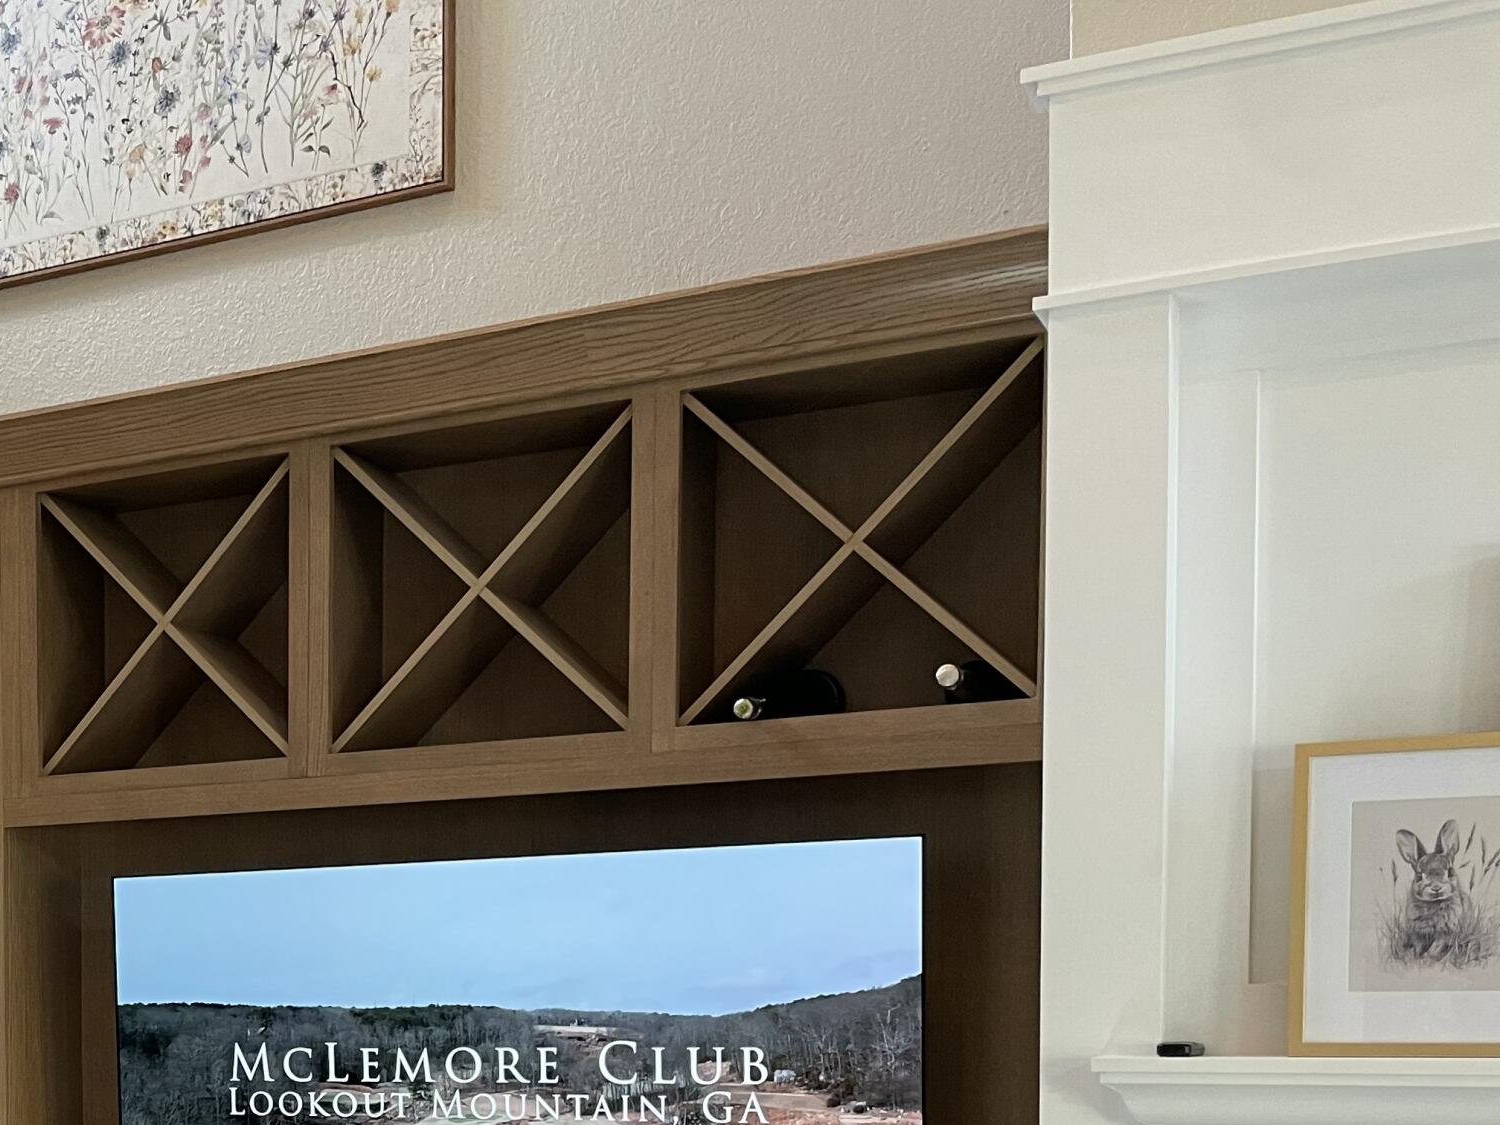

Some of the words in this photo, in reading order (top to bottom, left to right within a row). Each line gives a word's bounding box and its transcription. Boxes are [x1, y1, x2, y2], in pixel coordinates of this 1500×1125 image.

[598, 1039, 769, 1086] CLUB
[229, 1086, 411, 1118] LOOKOUT
[702, 1091, 770, 1125] GA
